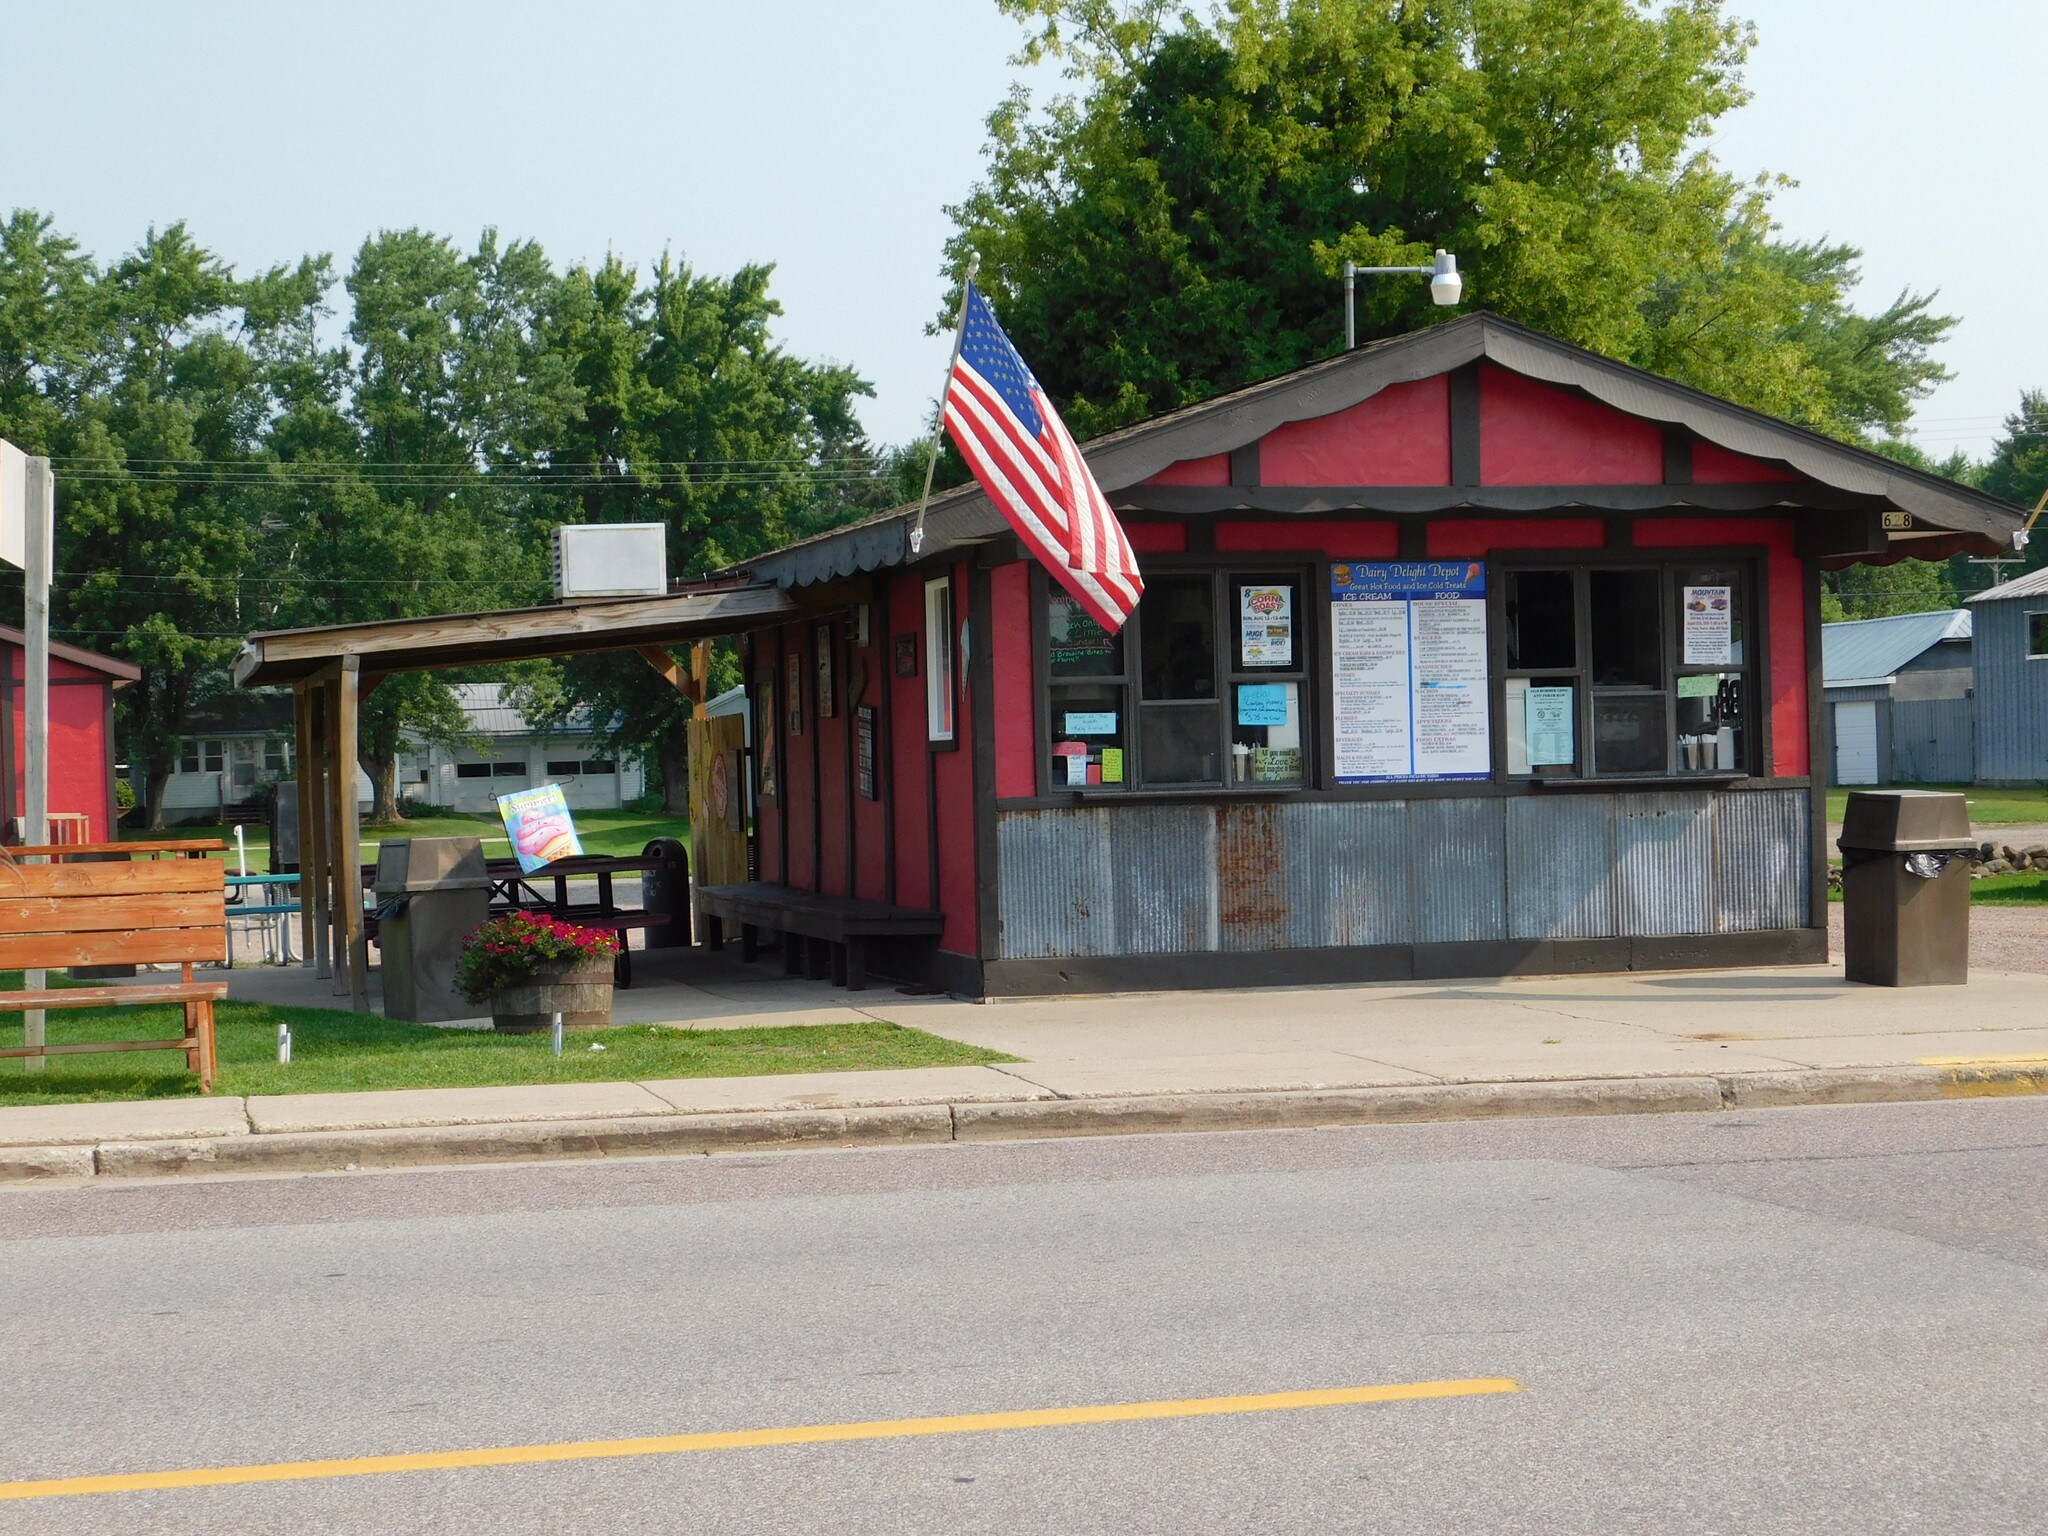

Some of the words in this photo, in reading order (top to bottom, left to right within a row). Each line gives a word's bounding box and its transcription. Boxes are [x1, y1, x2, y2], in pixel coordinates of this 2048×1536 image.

[1356, 564, 1387, 582] Dairy
[1390, 564, 1426, 582] Delight
[1428, 563, 1459, 581] Depot
[1384, 582, 1401, 590] Food
[1428, 581, 1444, 589] Cold
[1445, 581, 1466, 589] Treats
[1342, 593, 1358, 601] ICE
[1359, 592, 1392, 600] CREAM
[1435, 591, 1460, 600] FOOD
[1250, 595, 1279, 606] CORN
[1253, 602, 1283, 612] ROAST
[1269, 750, 1279, 758] you
[1268, 757, 1290, 766] Love
[511, 794, 557, 812] Summer!
